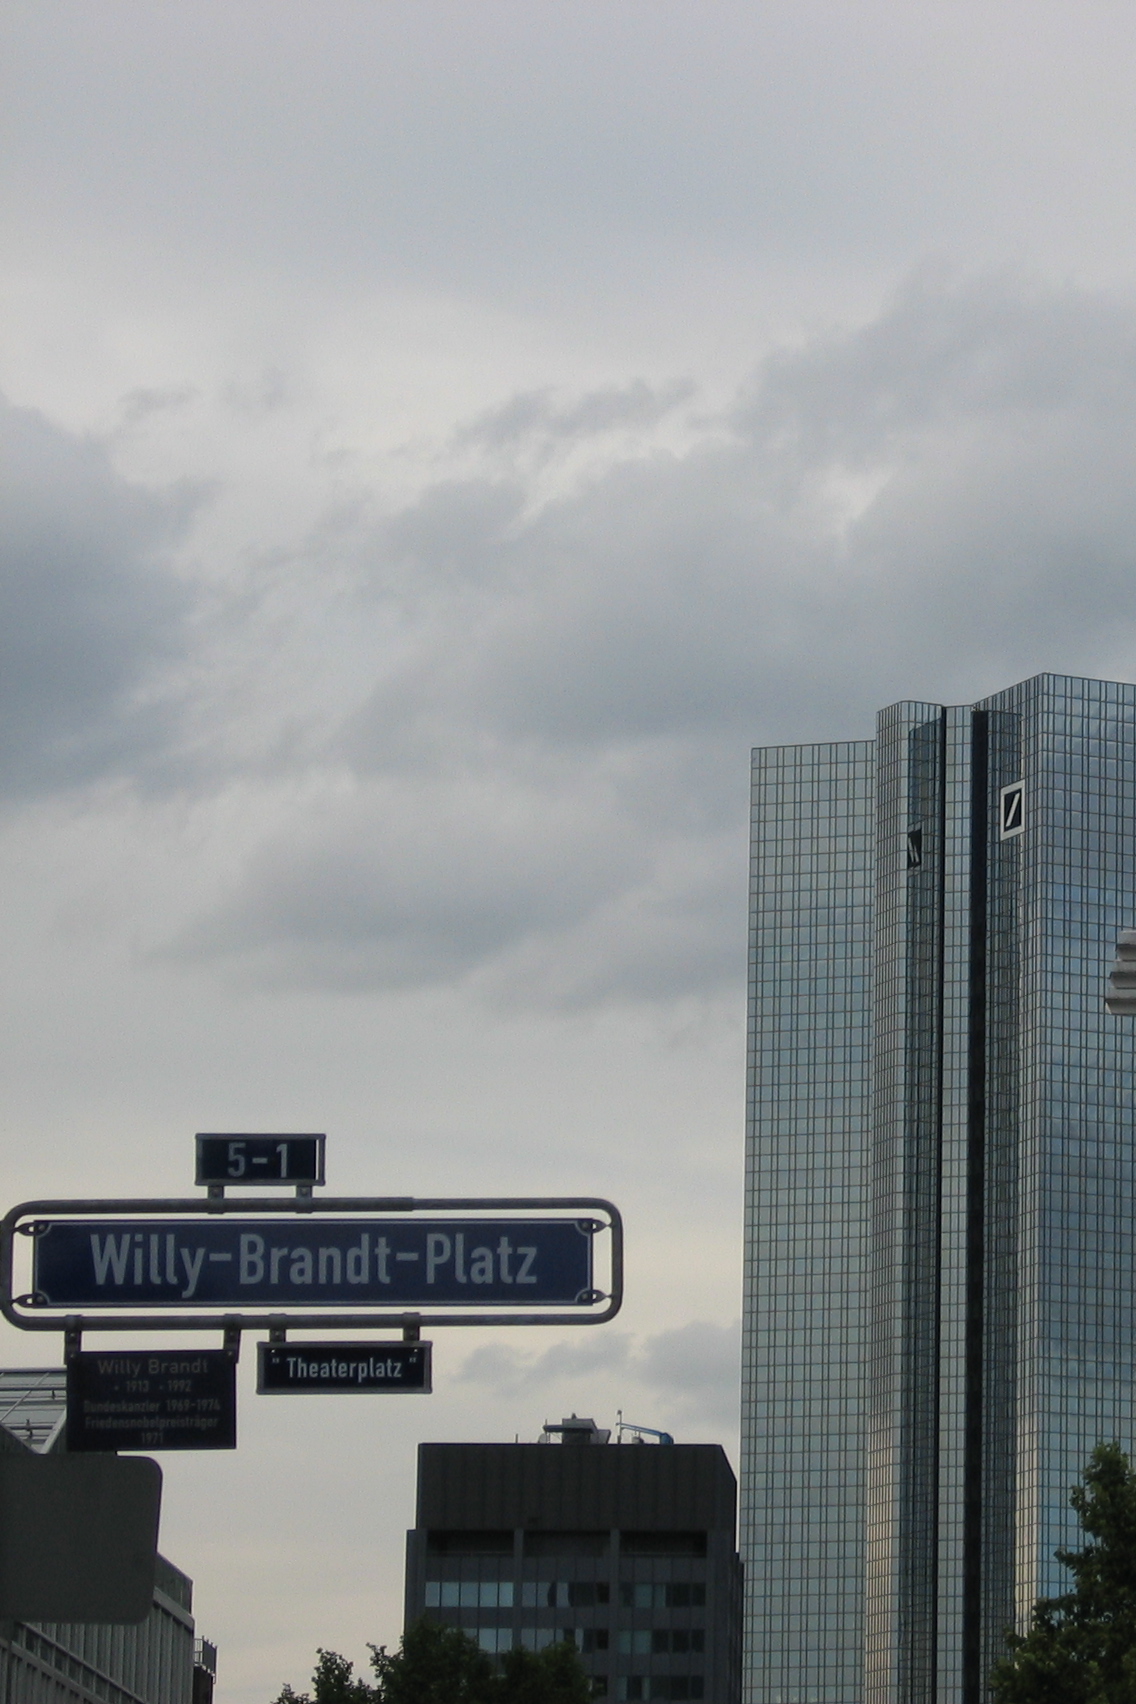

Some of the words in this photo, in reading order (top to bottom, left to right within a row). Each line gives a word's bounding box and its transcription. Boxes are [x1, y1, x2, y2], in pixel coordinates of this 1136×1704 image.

[227, 1141, 289, 1178] 5-1
[90, 1232, 538, 1299] Willy-Brandt-Platz
[97, 1358, 141, 1377] Willy
[148, 1358, 208, 1374] Brandt
[167, 1379, 192, 1392] 1992
[83, 1399, 160, 1413] Bundeskanzler
[166, 1398, 221, 1412] 1969-1974
[141, 1432, 164, 1445] 1971
